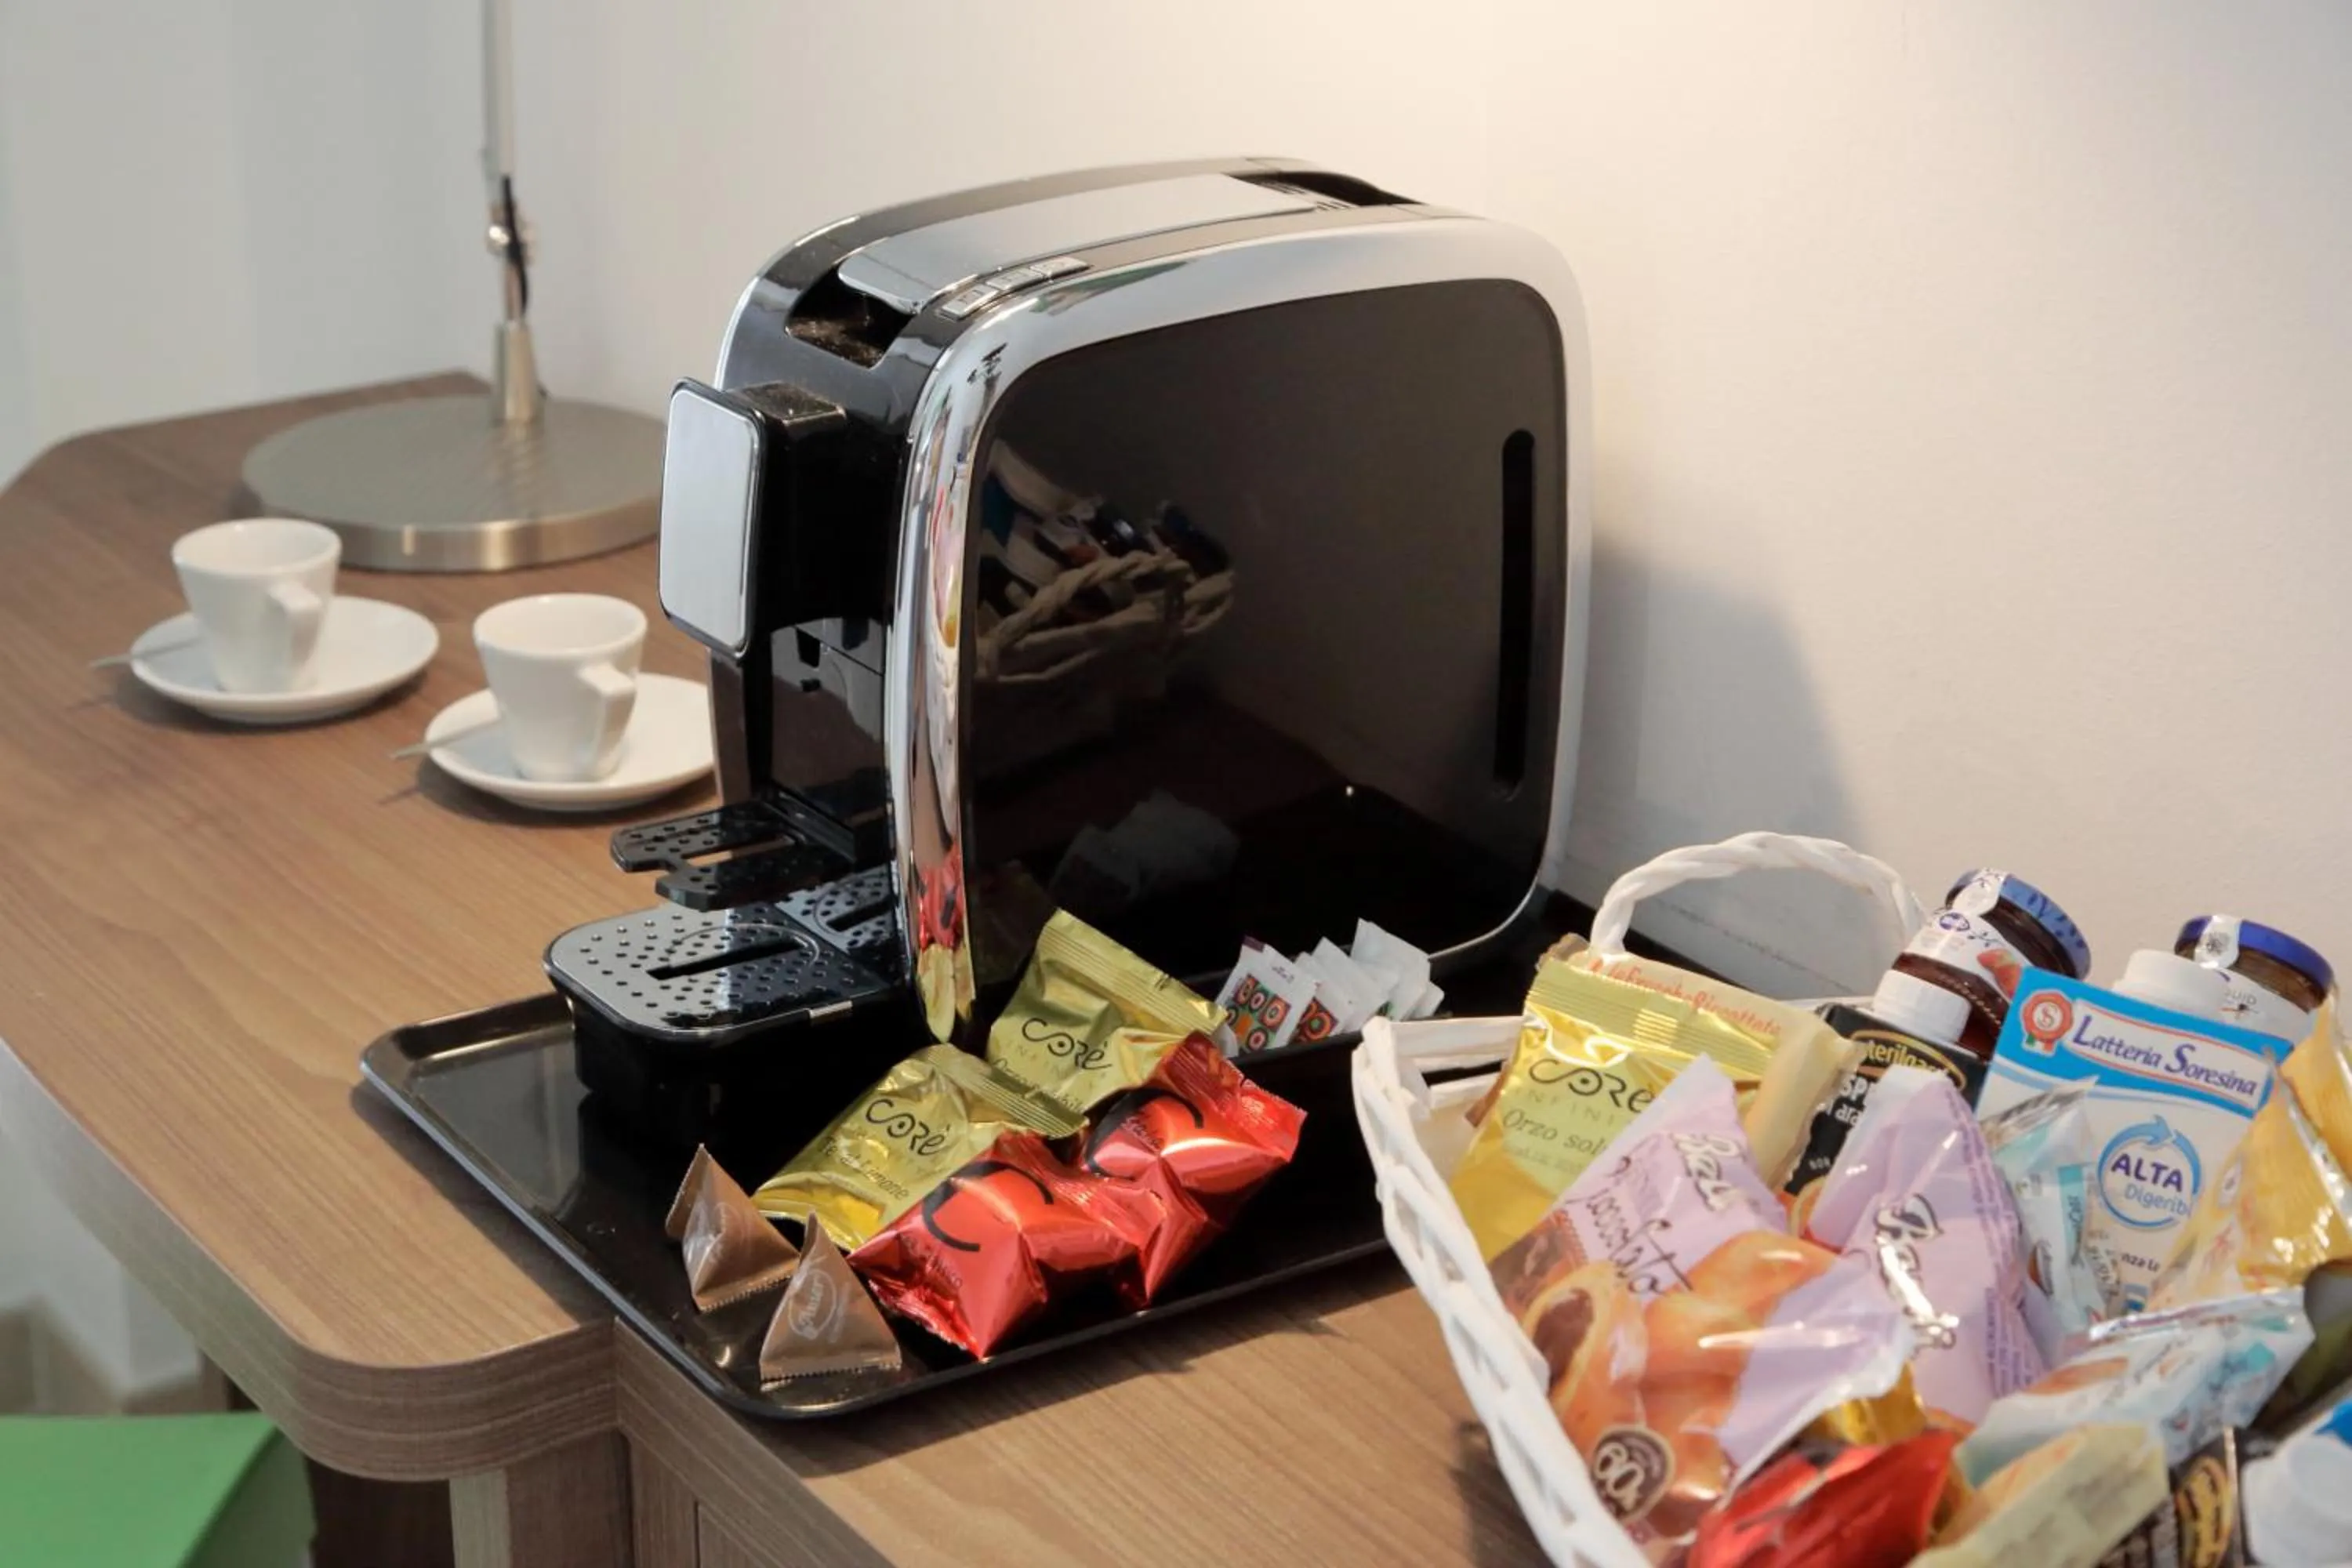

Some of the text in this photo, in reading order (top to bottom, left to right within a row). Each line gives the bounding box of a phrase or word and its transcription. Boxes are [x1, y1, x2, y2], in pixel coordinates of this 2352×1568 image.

[2073, 1015, 2258, 1096] Latteria Soresina
[1503, 1108, 1559, 1141] Orzo
[2111, 1152, 2183, 1192] ALTA
[2123, 1182, 2192, 1218] Digerib
